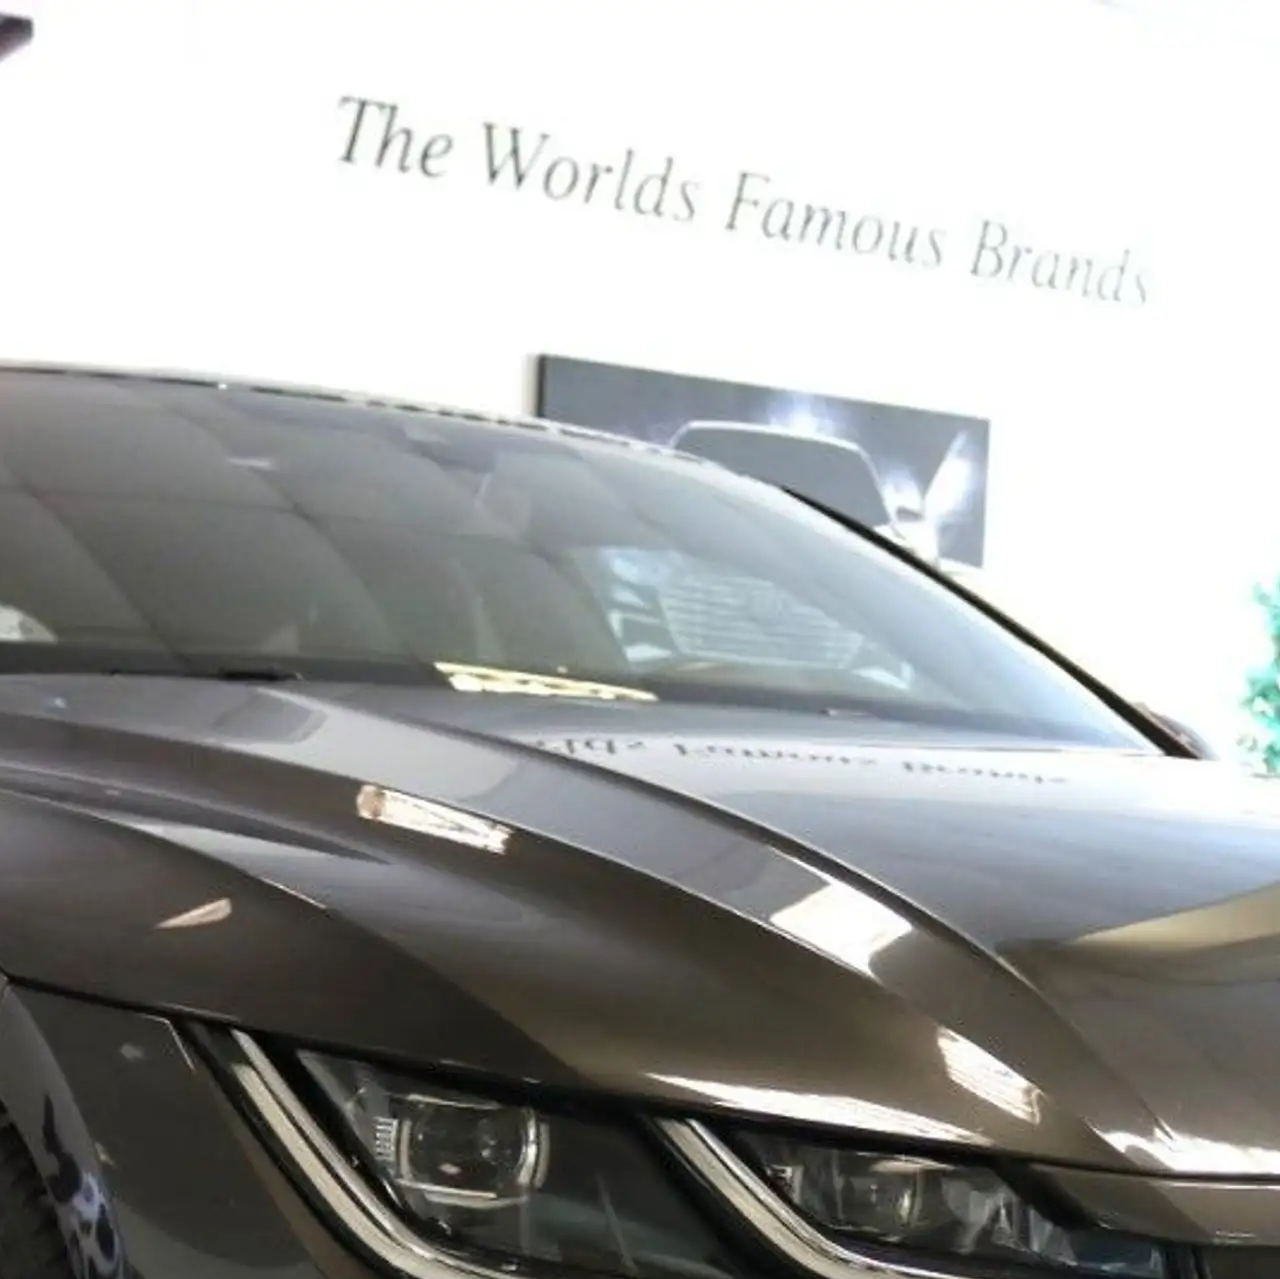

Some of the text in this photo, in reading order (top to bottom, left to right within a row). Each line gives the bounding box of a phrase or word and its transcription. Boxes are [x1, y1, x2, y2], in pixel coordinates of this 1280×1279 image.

[338, 95, 1148, 305] The Worlds Famous Brands
